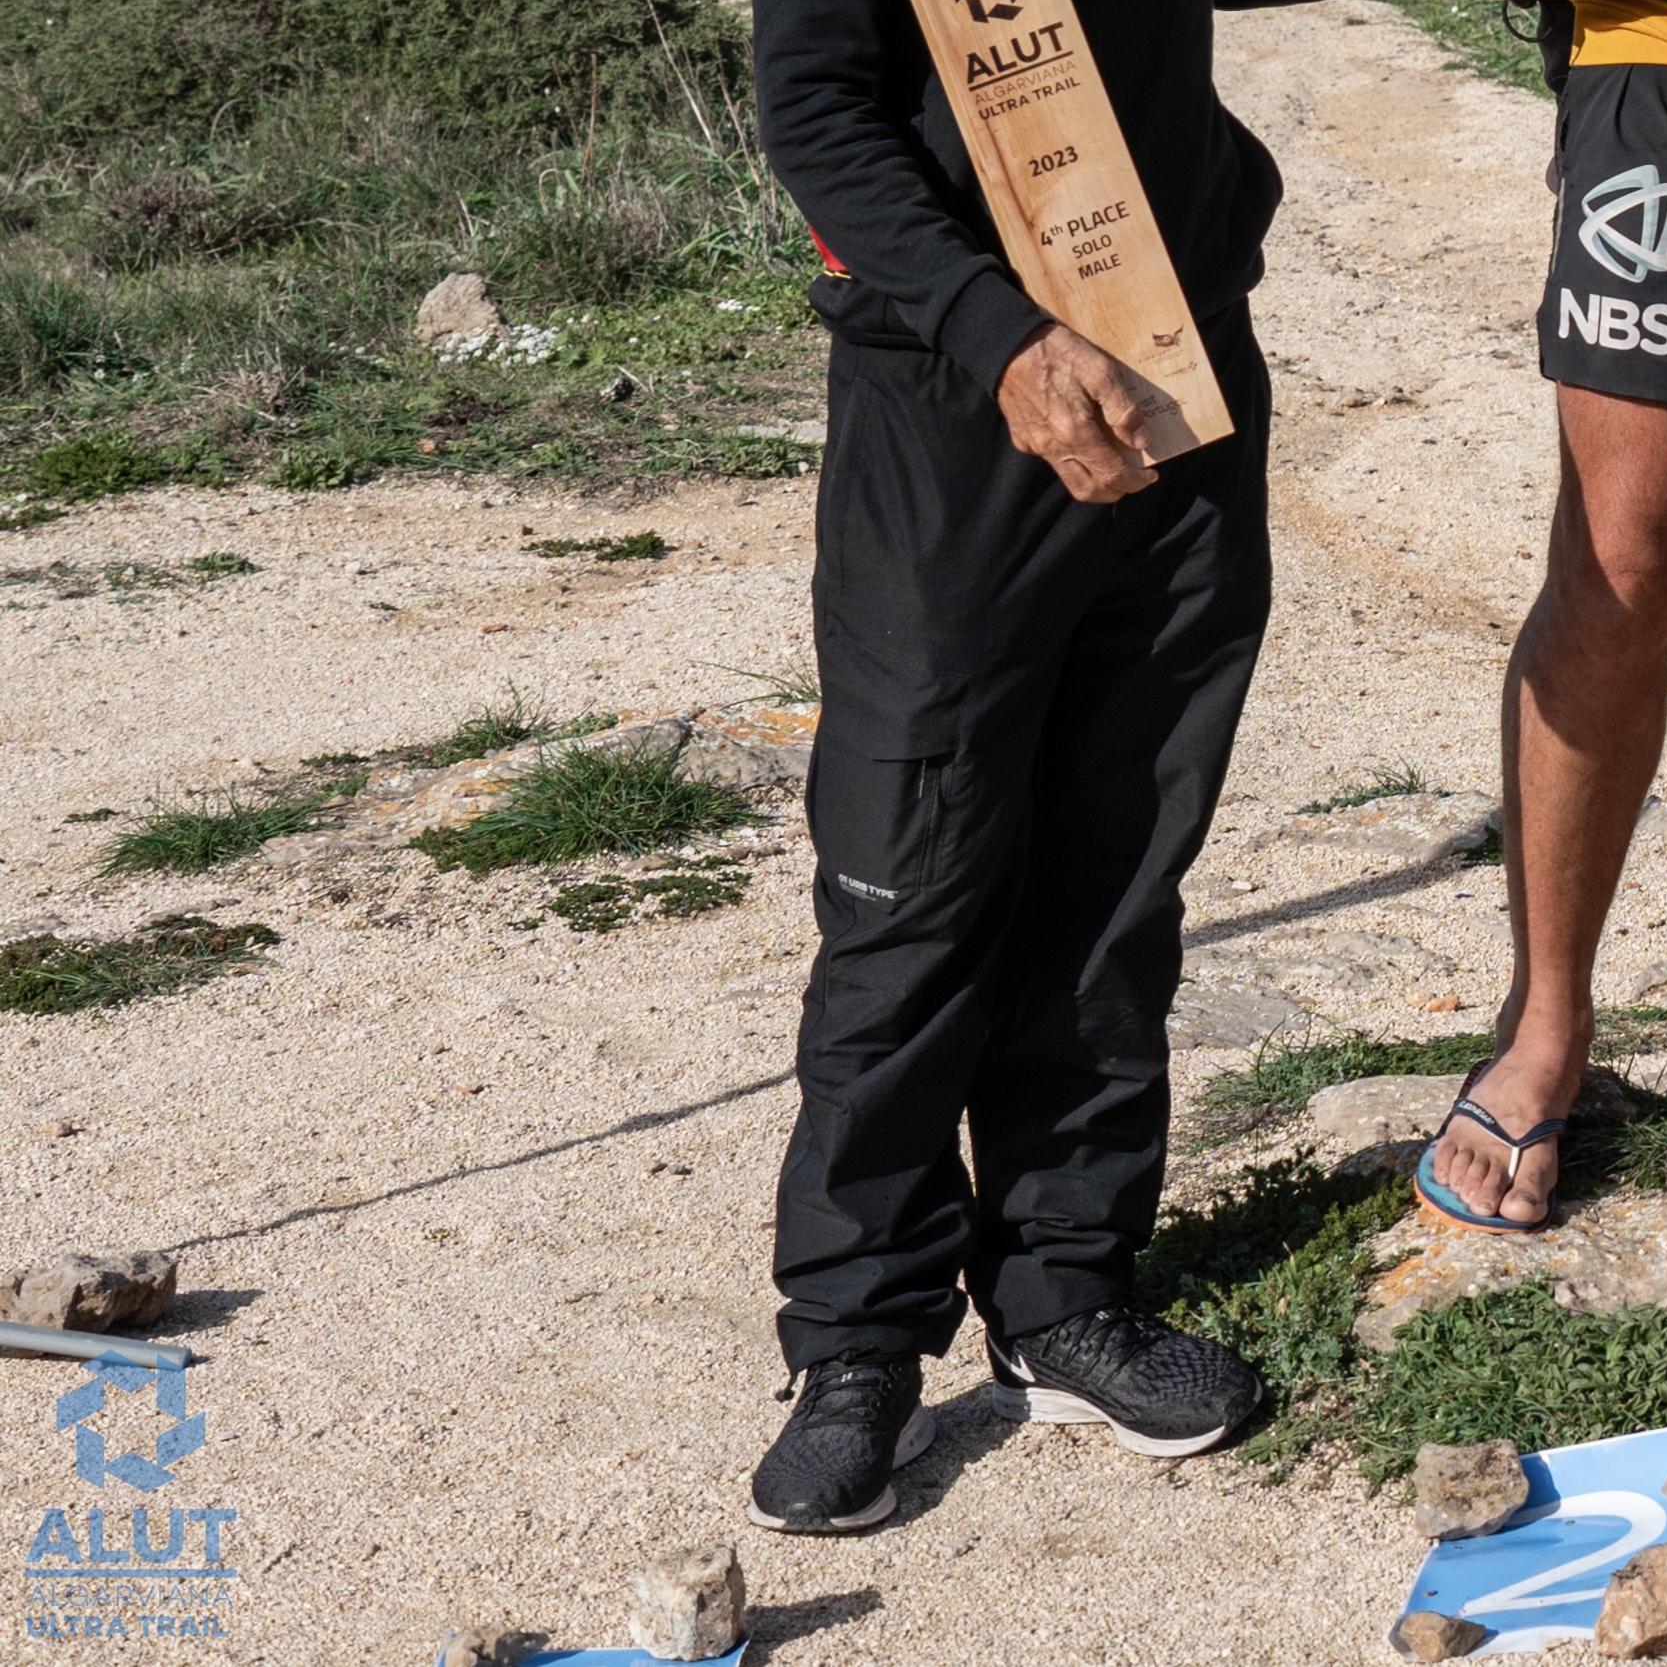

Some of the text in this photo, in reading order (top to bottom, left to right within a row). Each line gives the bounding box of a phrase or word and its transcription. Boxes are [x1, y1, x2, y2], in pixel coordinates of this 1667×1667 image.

[966, 21, 1064, 85] ALUT
[975, 59, 1078, 106] ALGARVIANA
[978, 76, 1082, 121] ULTRA TRAIL
[1028, 145, 1079, 178] 2023
[1040, 200, 1131, 247] 4th PLACE
[1071, 233, 1113, 259] SOLO
[1077, 253, 1123, 281] MALE
[1463, 1490, 1667, 1617] 2
